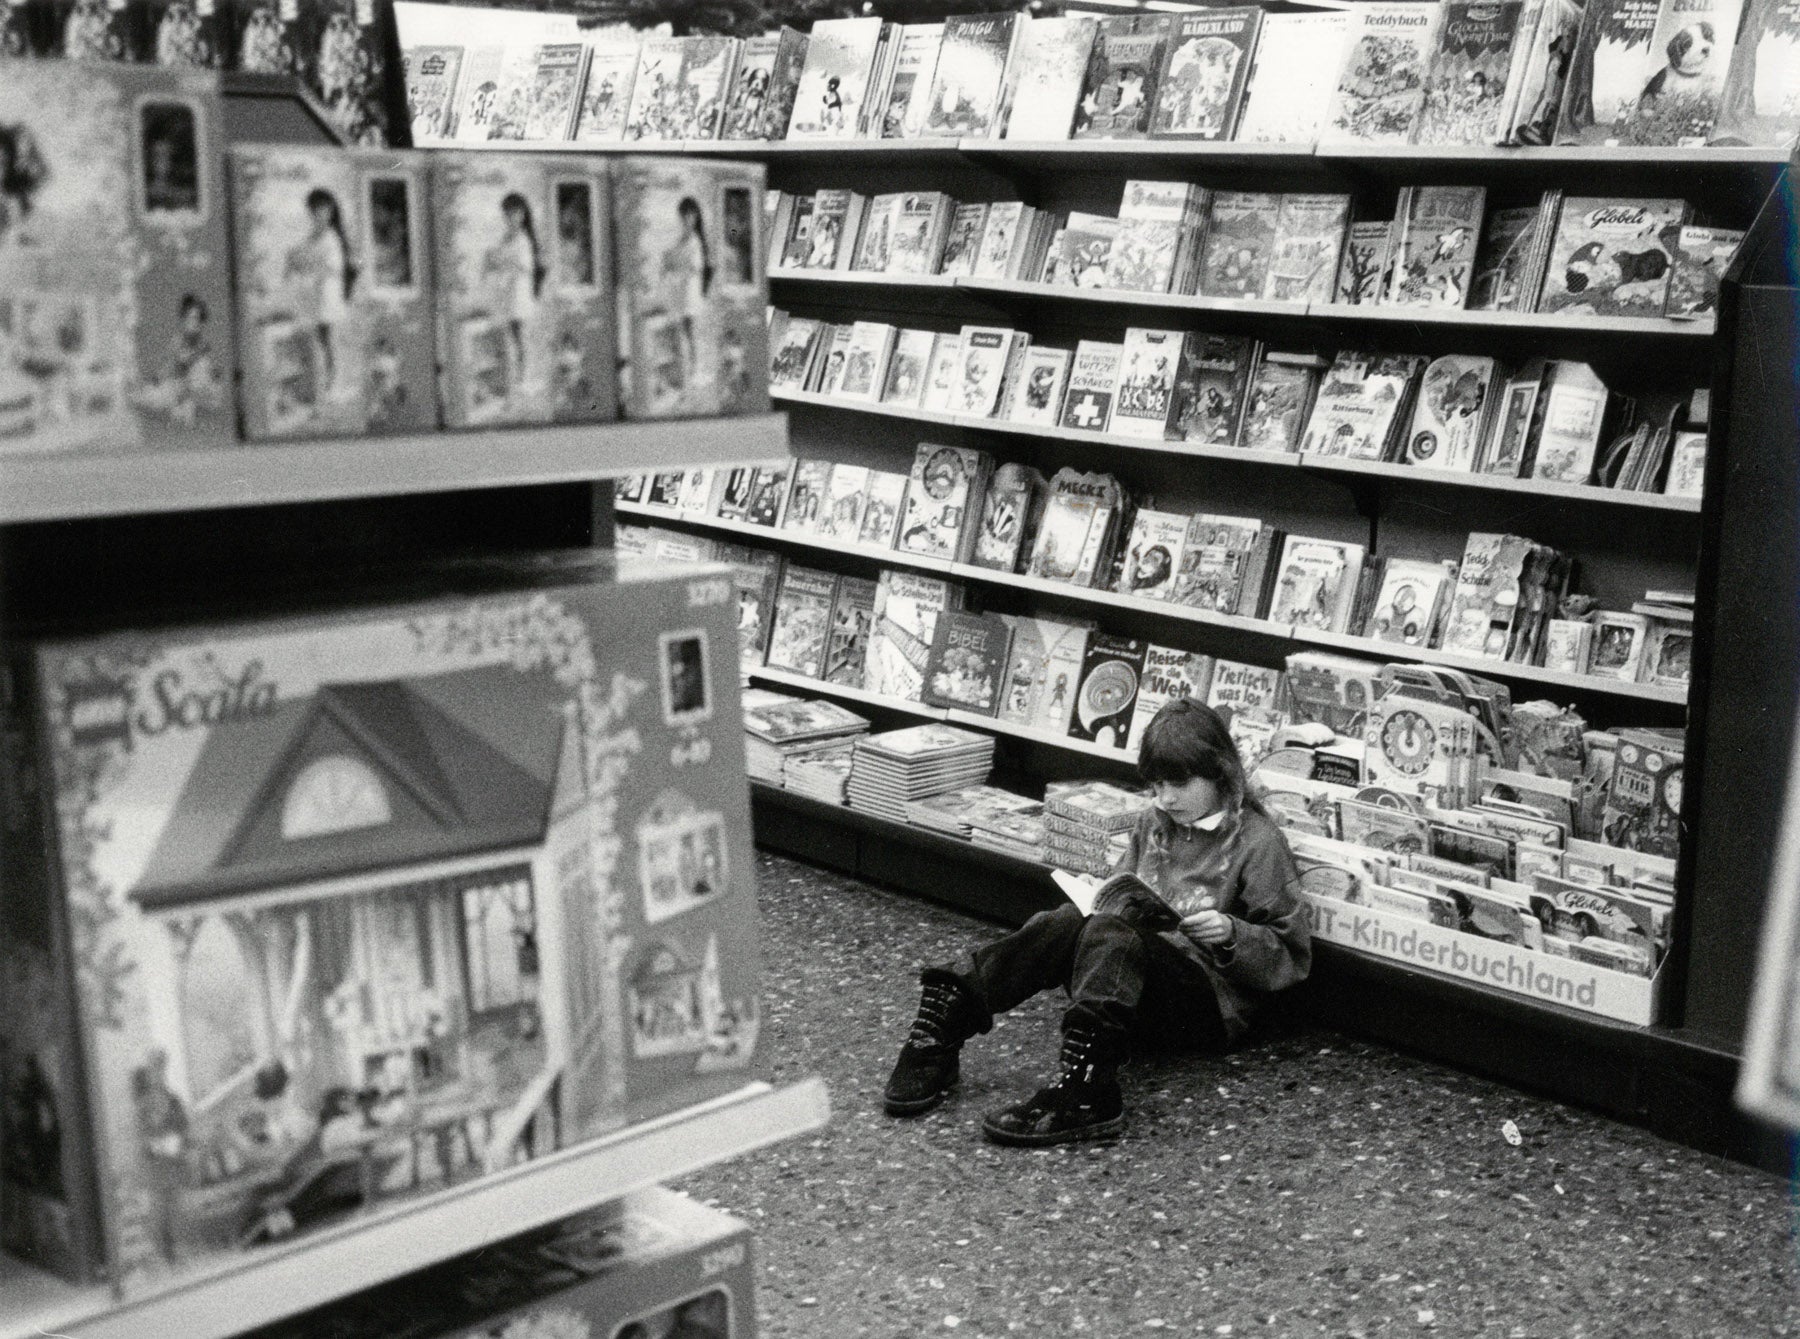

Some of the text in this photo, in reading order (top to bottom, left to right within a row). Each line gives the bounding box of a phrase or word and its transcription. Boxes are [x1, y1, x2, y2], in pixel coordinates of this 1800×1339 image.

[957, 20, 995, 36] PINGU
[1364, 14, 1428, 28] Teddybuch
[1590, 207, 1647, 229] Globeli
[1057, 480, 1107, 498] MECKI
[948, 629, 989, 653] BIBEL
[1147, 649, 1187, 666] Reise
[1166, 667, 1182, 679] die
[1151, 675, 1193, 698] Welt
[1216, 688, 1241, 701] was
[1564, 891, 1614, 917] Globeli
